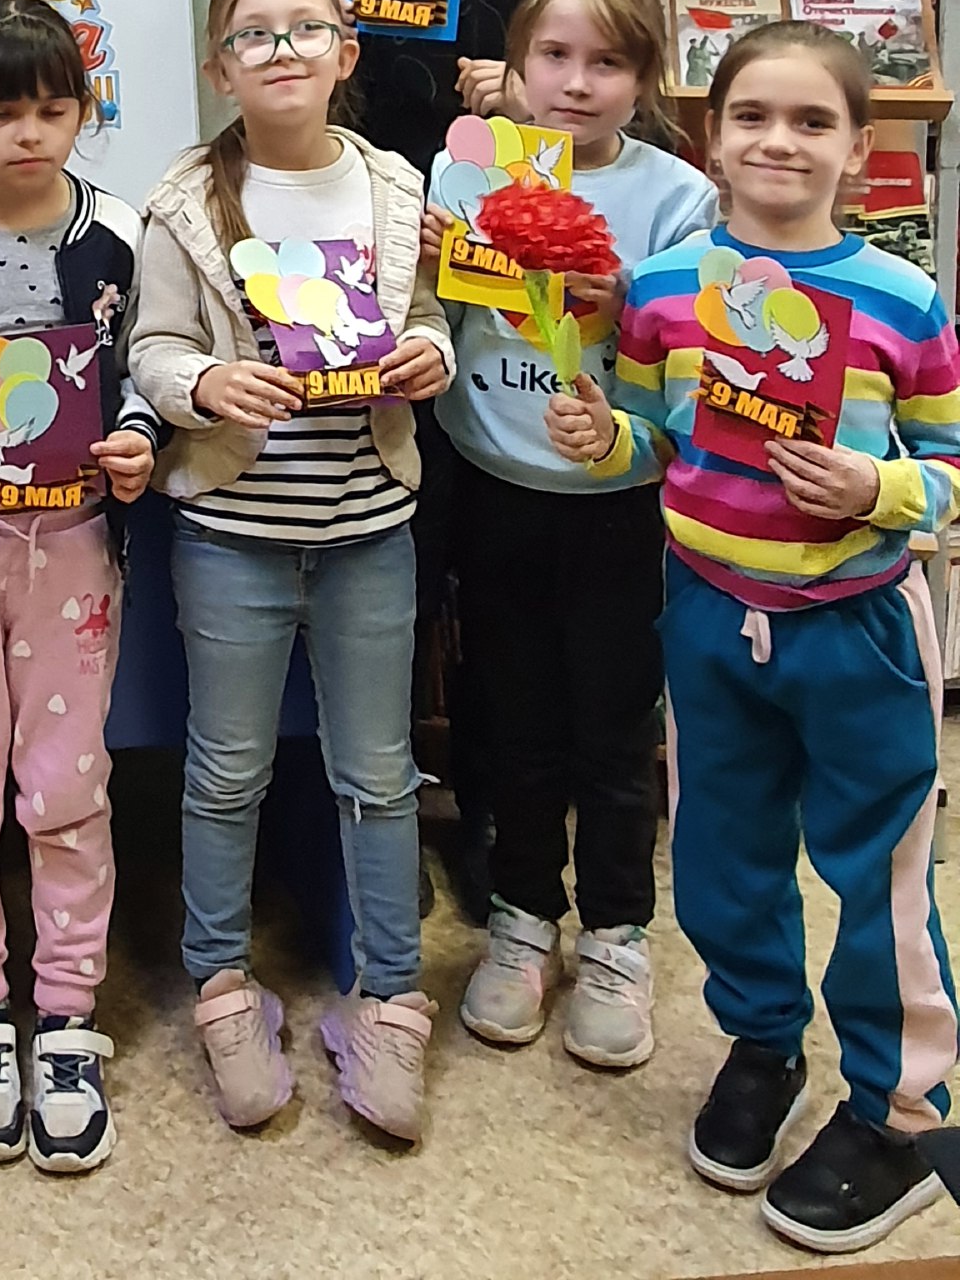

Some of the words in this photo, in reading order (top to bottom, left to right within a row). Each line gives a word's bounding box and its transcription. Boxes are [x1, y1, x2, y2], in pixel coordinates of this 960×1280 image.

[453, 238, 470, 262] 9
[309, 371, 324, 395] 9
[328, 371, 381, 396] МАЯ
[710, 382, 732, 406] 9
[734, 390, 800, 438] МАЯ
[1, 483, 19, 506] 9
[24, 481, 82, 508] МАЯ
